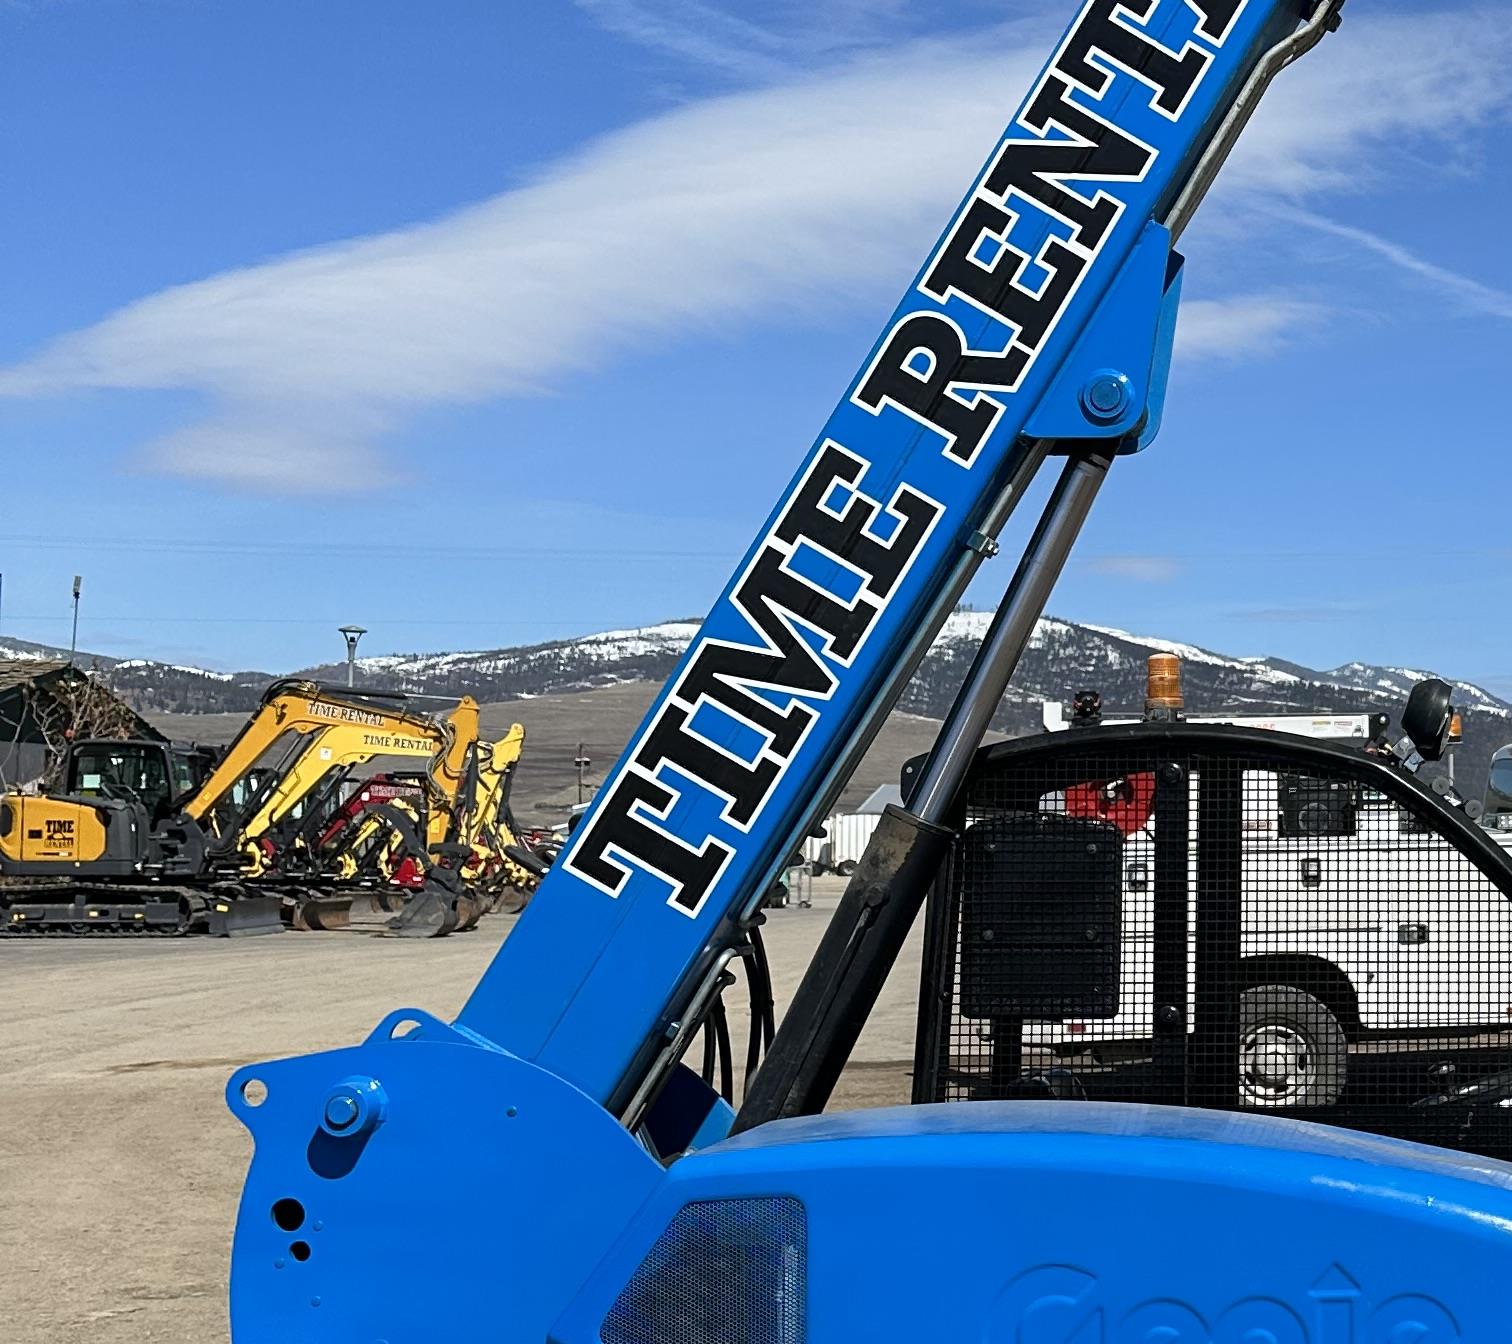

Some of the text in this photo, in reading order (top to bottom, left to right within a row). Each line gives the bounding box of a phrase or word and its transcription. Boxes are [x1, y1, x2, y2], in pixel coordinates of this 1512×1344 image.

[568, 448, 945, 916] TIME
[308, 702, 385, 726] TIME RENTAL
[363, 735, 391, 747] TIME
[45, 819, 75, 833] TIME
